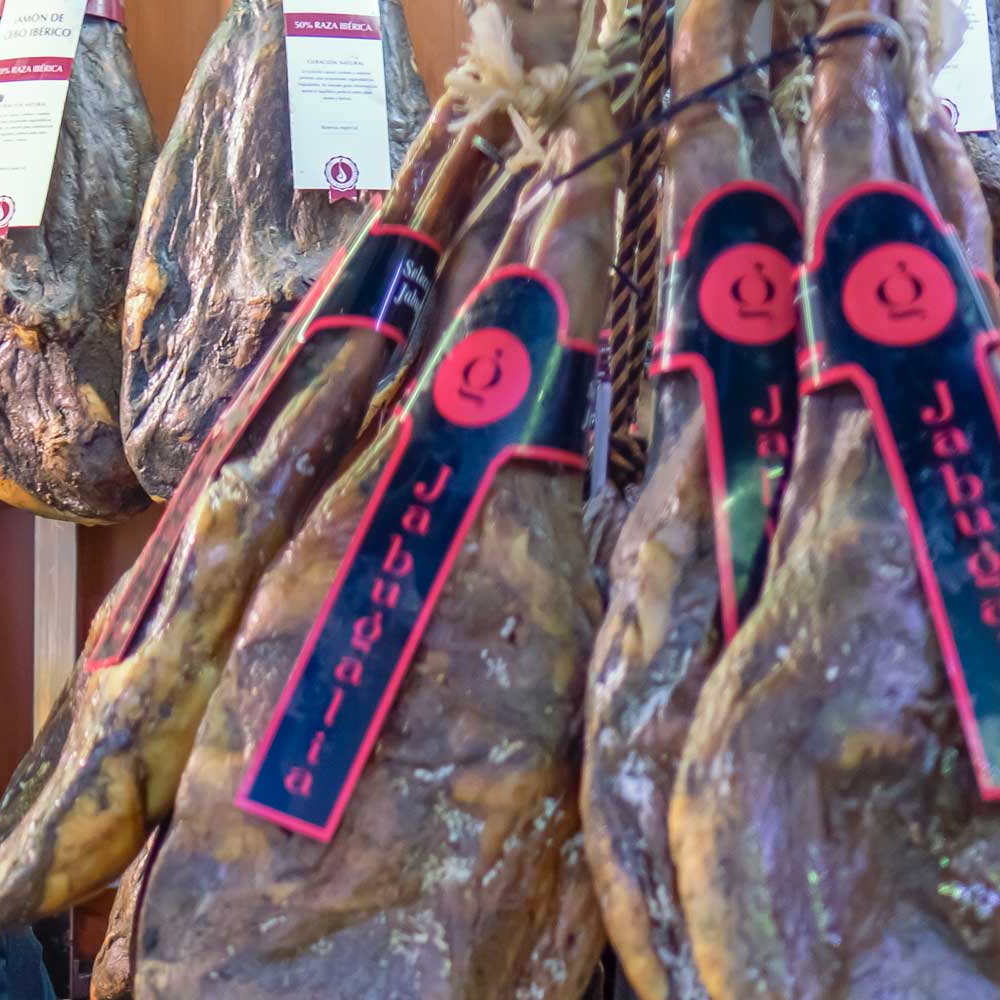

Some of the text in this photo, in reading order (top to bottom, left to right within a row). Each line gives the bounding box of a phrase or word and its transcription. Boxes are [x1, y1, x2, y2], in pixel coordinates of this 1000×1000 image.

[50, 12, 65, 23] DE
[314, 20, 339, 31] RAZA
[339, 20, 374, 32] IBÉRICA
[10, 64, 32, 75] RAZA
[32, 62, 63, 74] IBÉRICA
[283, 463, 453, 798] Jabugalia
